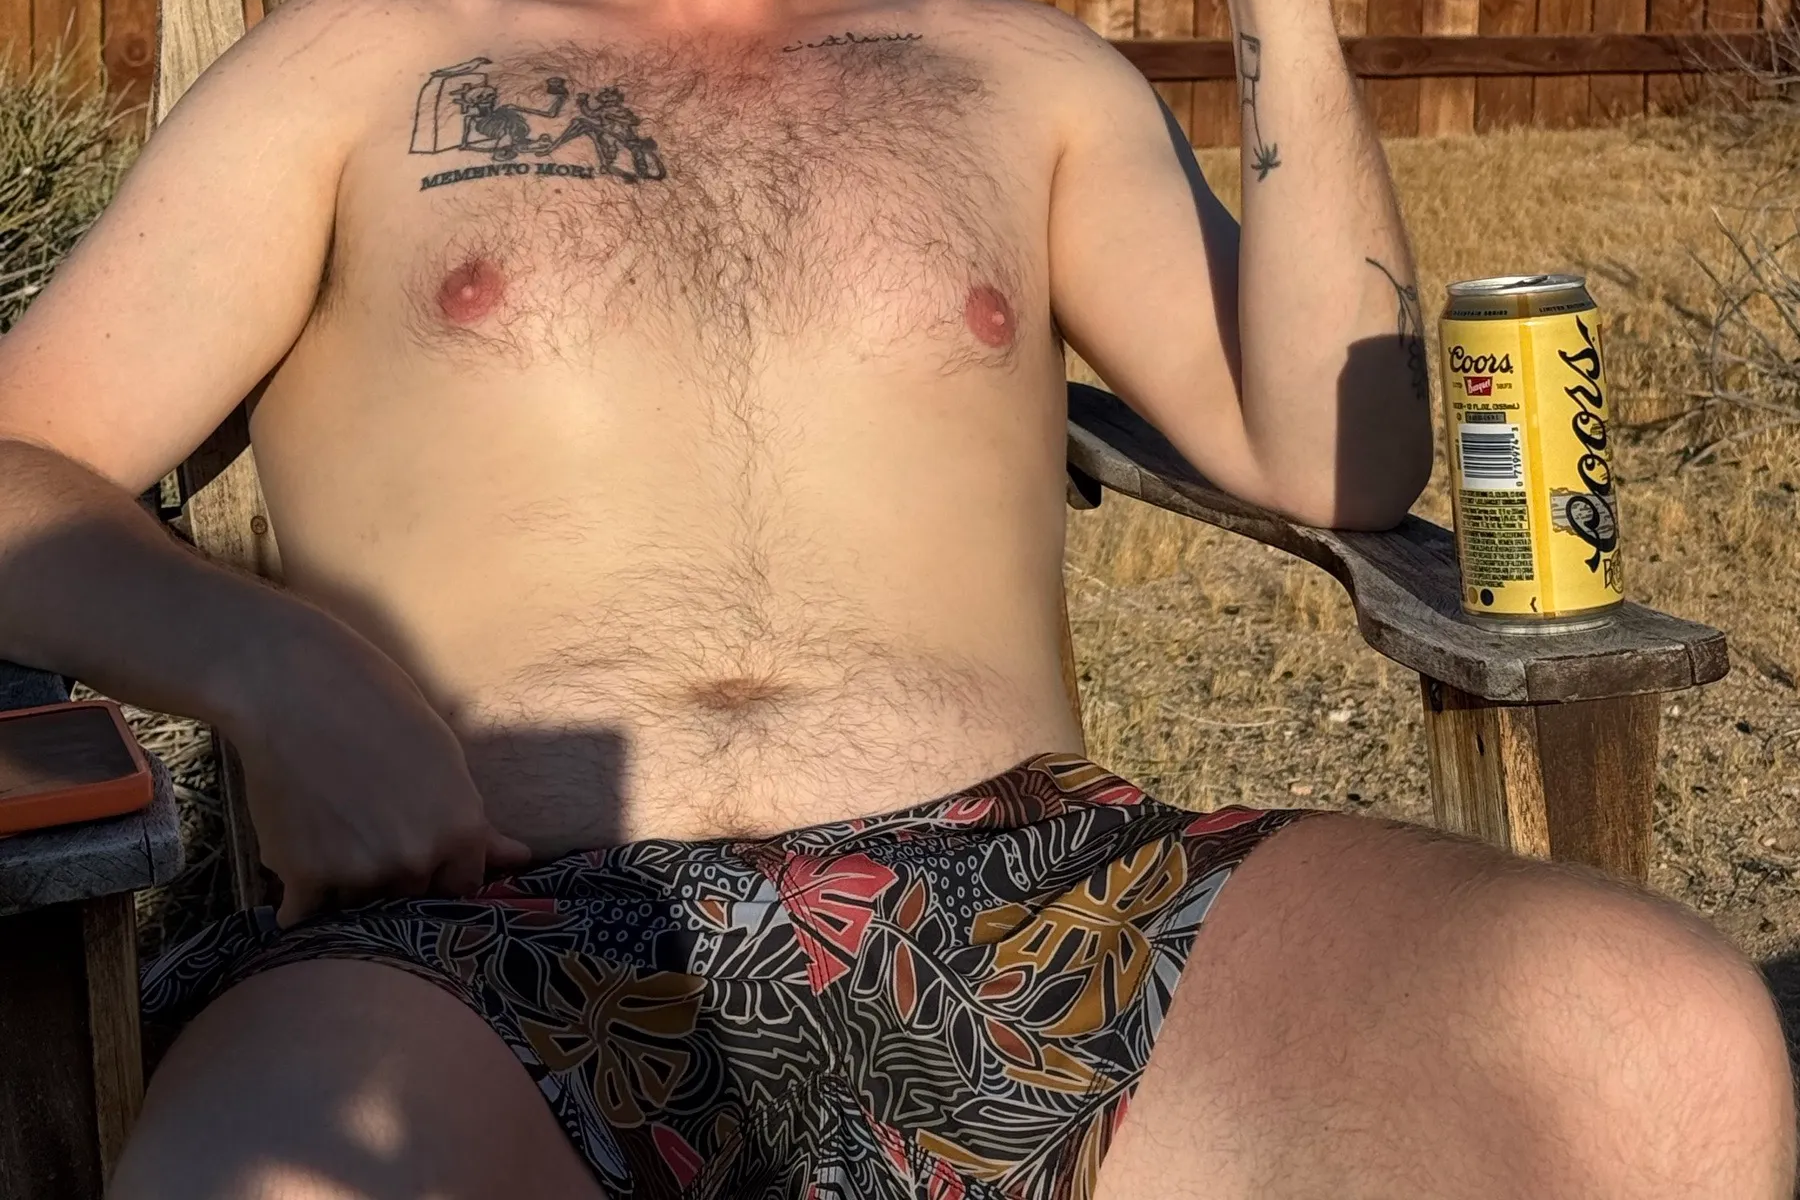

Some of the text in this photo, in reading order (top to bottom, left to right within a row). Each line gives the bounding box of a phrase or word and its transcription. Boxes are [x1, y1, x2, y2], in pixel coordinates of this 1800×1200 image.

[419, 162, 530, 191] MEMENTO
[1448, 345, 1511, 374] Coors
[1557, 314, 1617, 574] Coors
